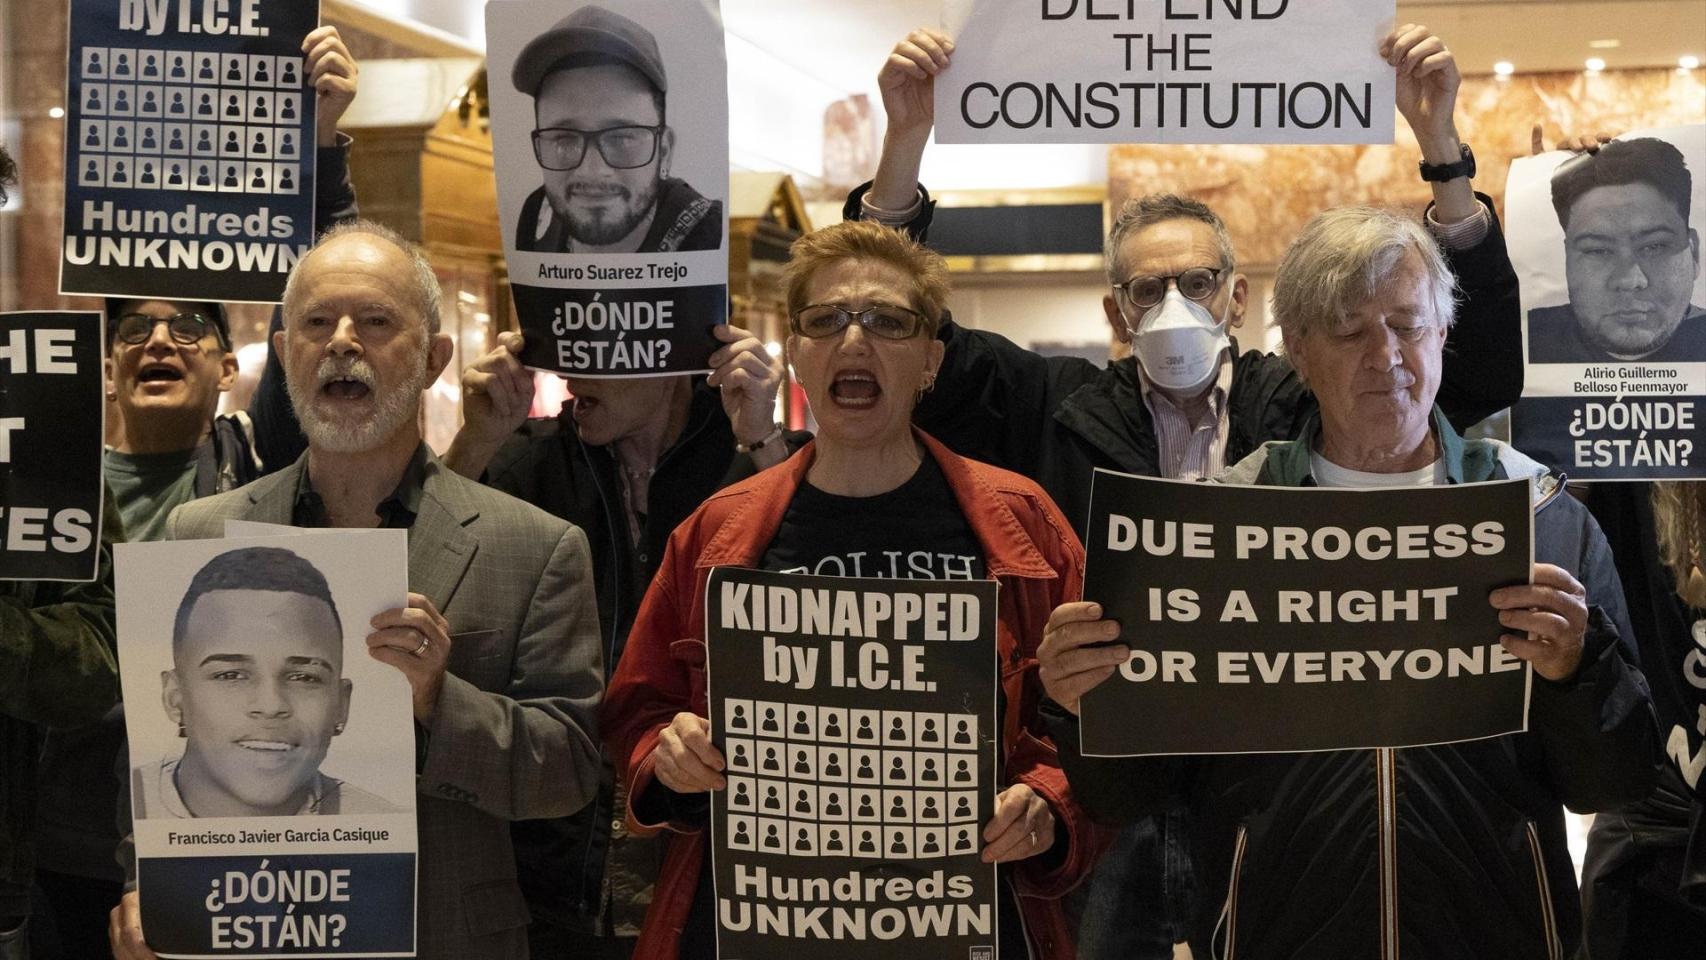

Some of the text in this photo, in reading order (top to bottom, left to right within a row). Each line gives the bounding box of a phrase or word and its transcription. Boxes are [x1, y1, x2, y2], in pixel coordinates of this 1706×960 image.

[119, 0, 270, 37] by I.C.E.
[1113, 34, 1212, 71] THE
[960, 81, 1372, 130] CONSTITUTION
[82, 200, 294, 239] Hundreds
[65, 235, 308, 274] UNKNOWN
[538, 261, 688, 282] Arturo Suarez Trejo
[551, 292, 674, 337] ¿DÓNDE
[556, 331, 672, 370] ESTÁN?
[1573, 381, 1689, 395] Belloso Fuenmayor
[1583, 366, 1678, 379] Alirio Guillermo
[1568, 393, 1695, 437] ¿DÓNDE
[1574, 430, 1693, 468] ESTÁN?
[0, 506, 92, 553] ES
[1107, 513, 1506, 561] DUE PROCESS
[779, 550, 977, 582] OLISH
[721, 581, 981, 642] KIDNAPPED
[1148, 586, 1459, 623] IS A RIGHT
[762, 636, 938, 692] by I.C.E.
[1119, 643, 1521, 684] OR EVERYONE
[168, 827, 390, 845] Francisco Javier Garcia Casique
[205, 858, 351, 913] ¿DÓNDE
[734, 863, 974, 902] Hundreds
[211, 903, 347, 949] ESTÁN?
[719, 898, 991, 941] UNKNOWN
